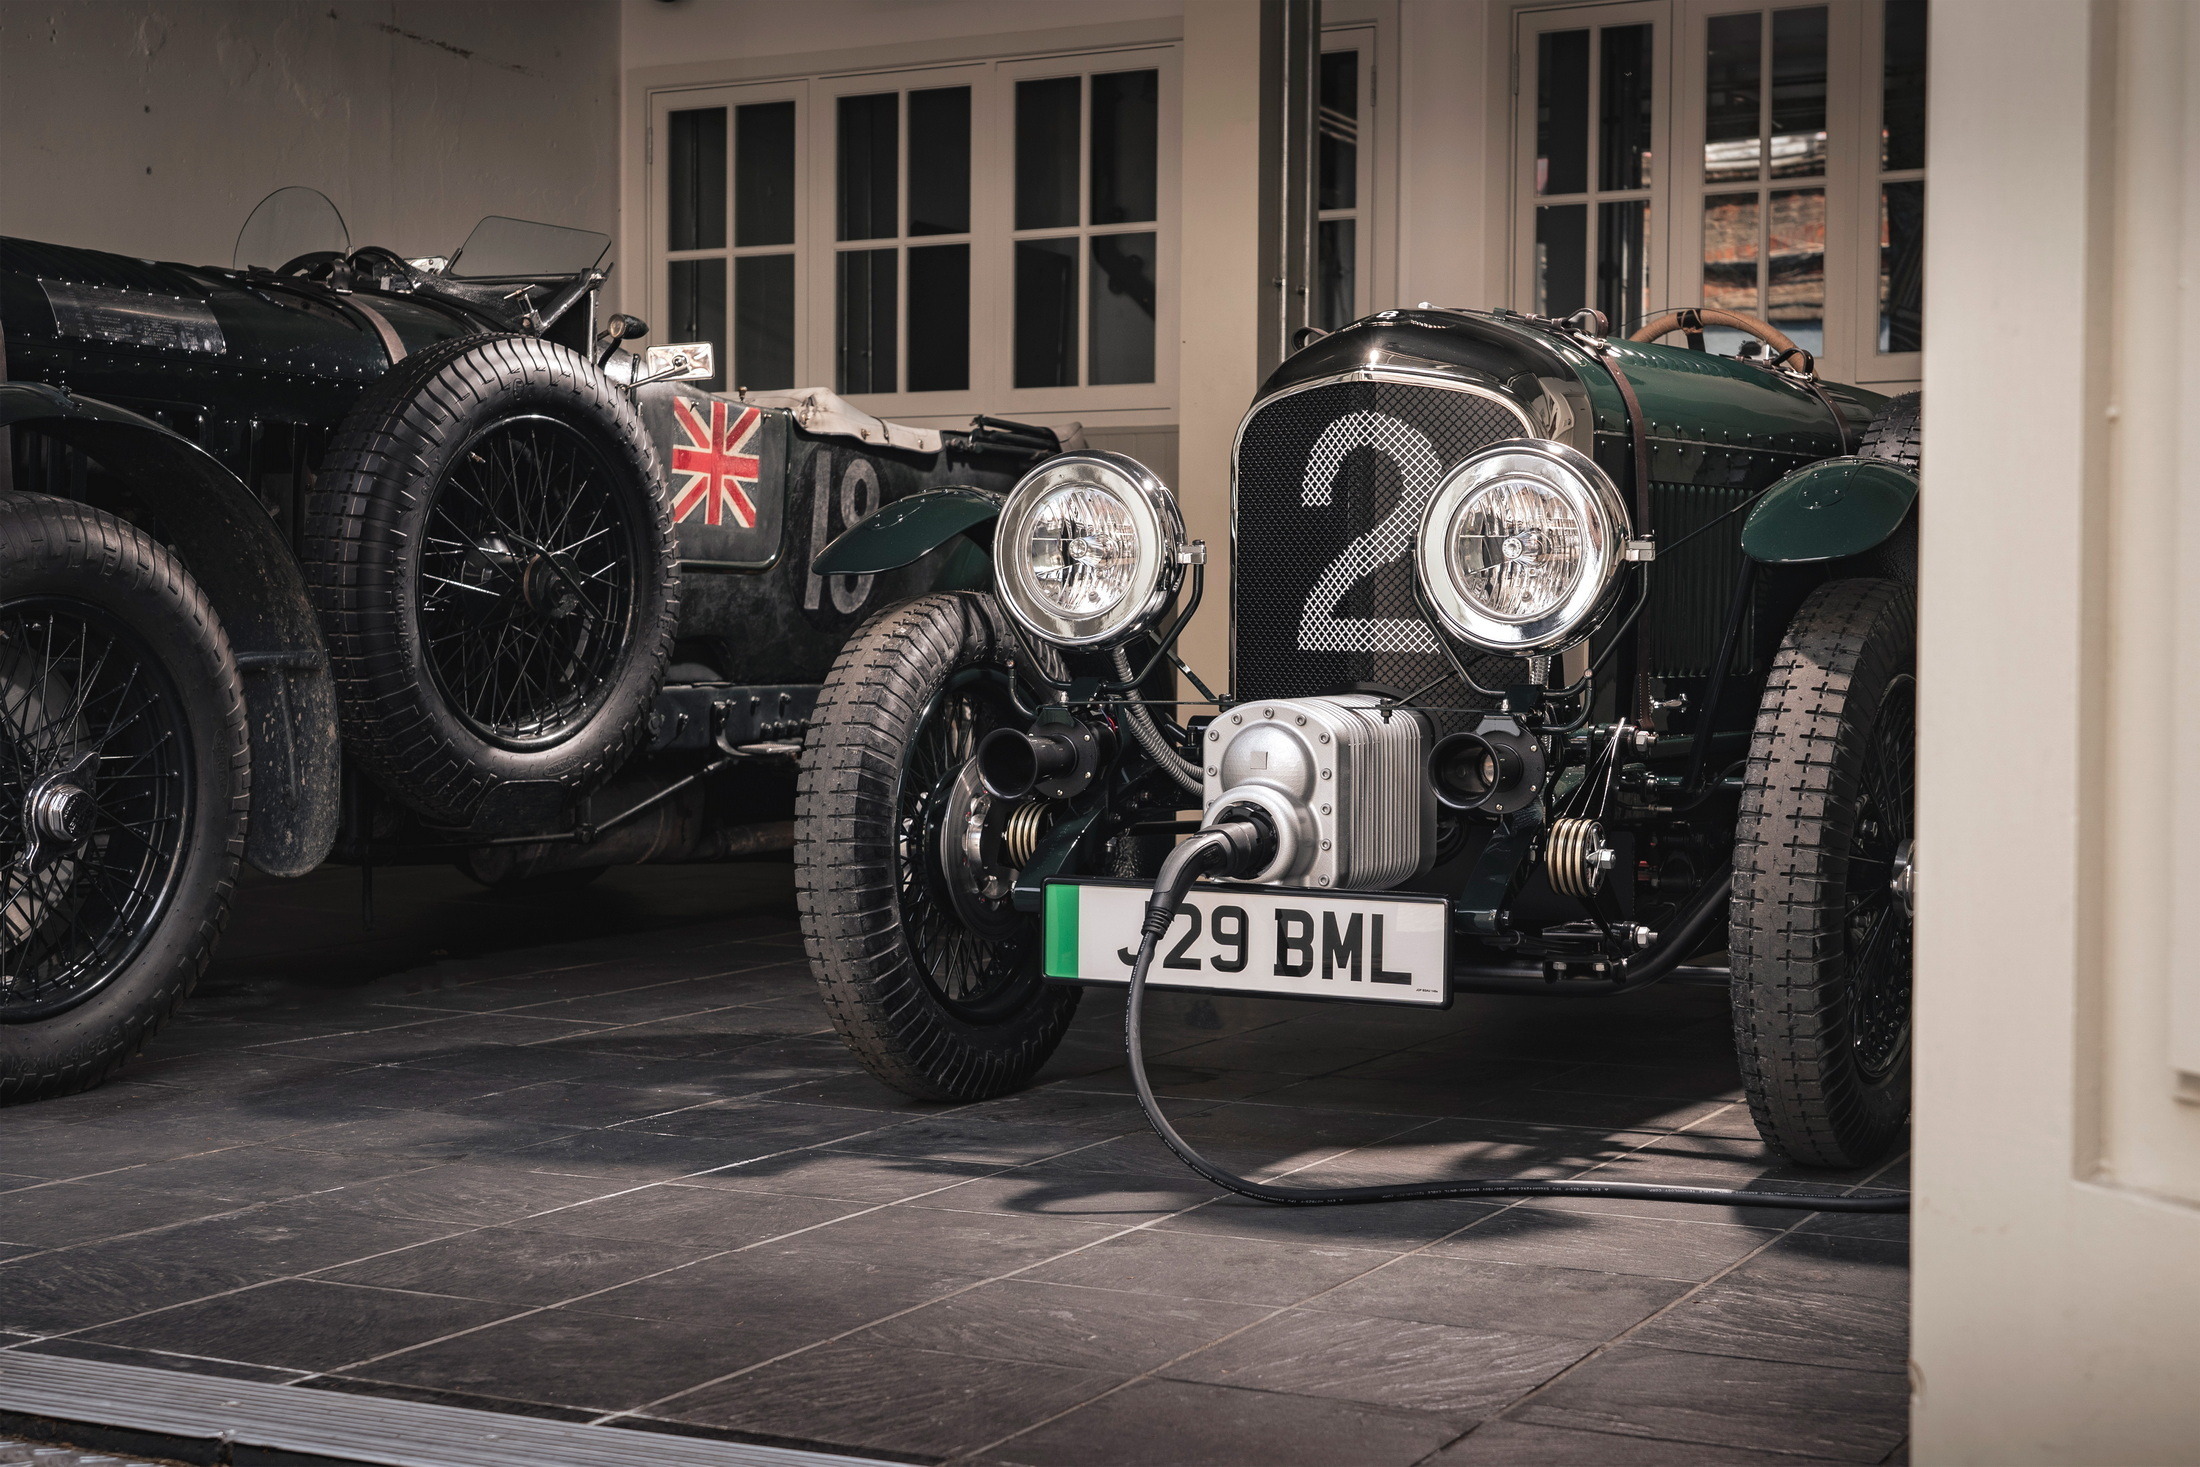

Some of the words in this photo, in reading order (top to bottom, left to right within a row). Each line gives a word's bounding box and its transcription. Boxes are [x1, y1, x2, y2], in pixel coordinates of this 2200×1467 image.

[803, 450, 880, 615] 18
[1298, 409, 1444, 653] 2
[1273, 908, 1412, 985] BML
